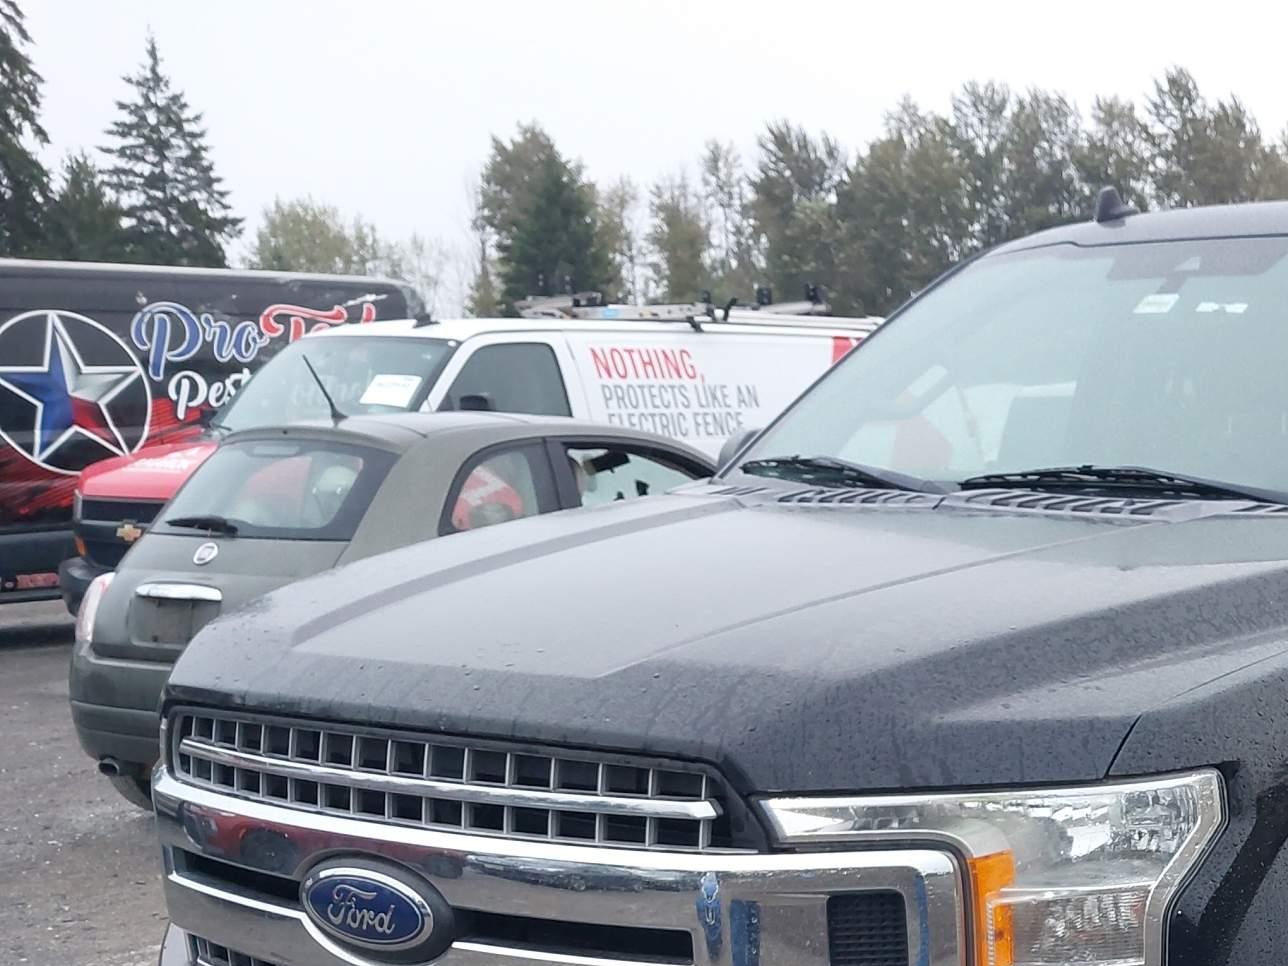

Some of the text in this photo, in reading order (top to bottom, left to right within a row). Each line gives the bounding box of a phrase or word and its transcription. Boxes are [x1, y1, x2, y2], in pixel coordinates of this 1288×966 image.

[601, 384, 760, 409] PROTECTS LIKE AN
[693, 412, 744, 437] FENCE
[327, 884, 396, 934] Ford
